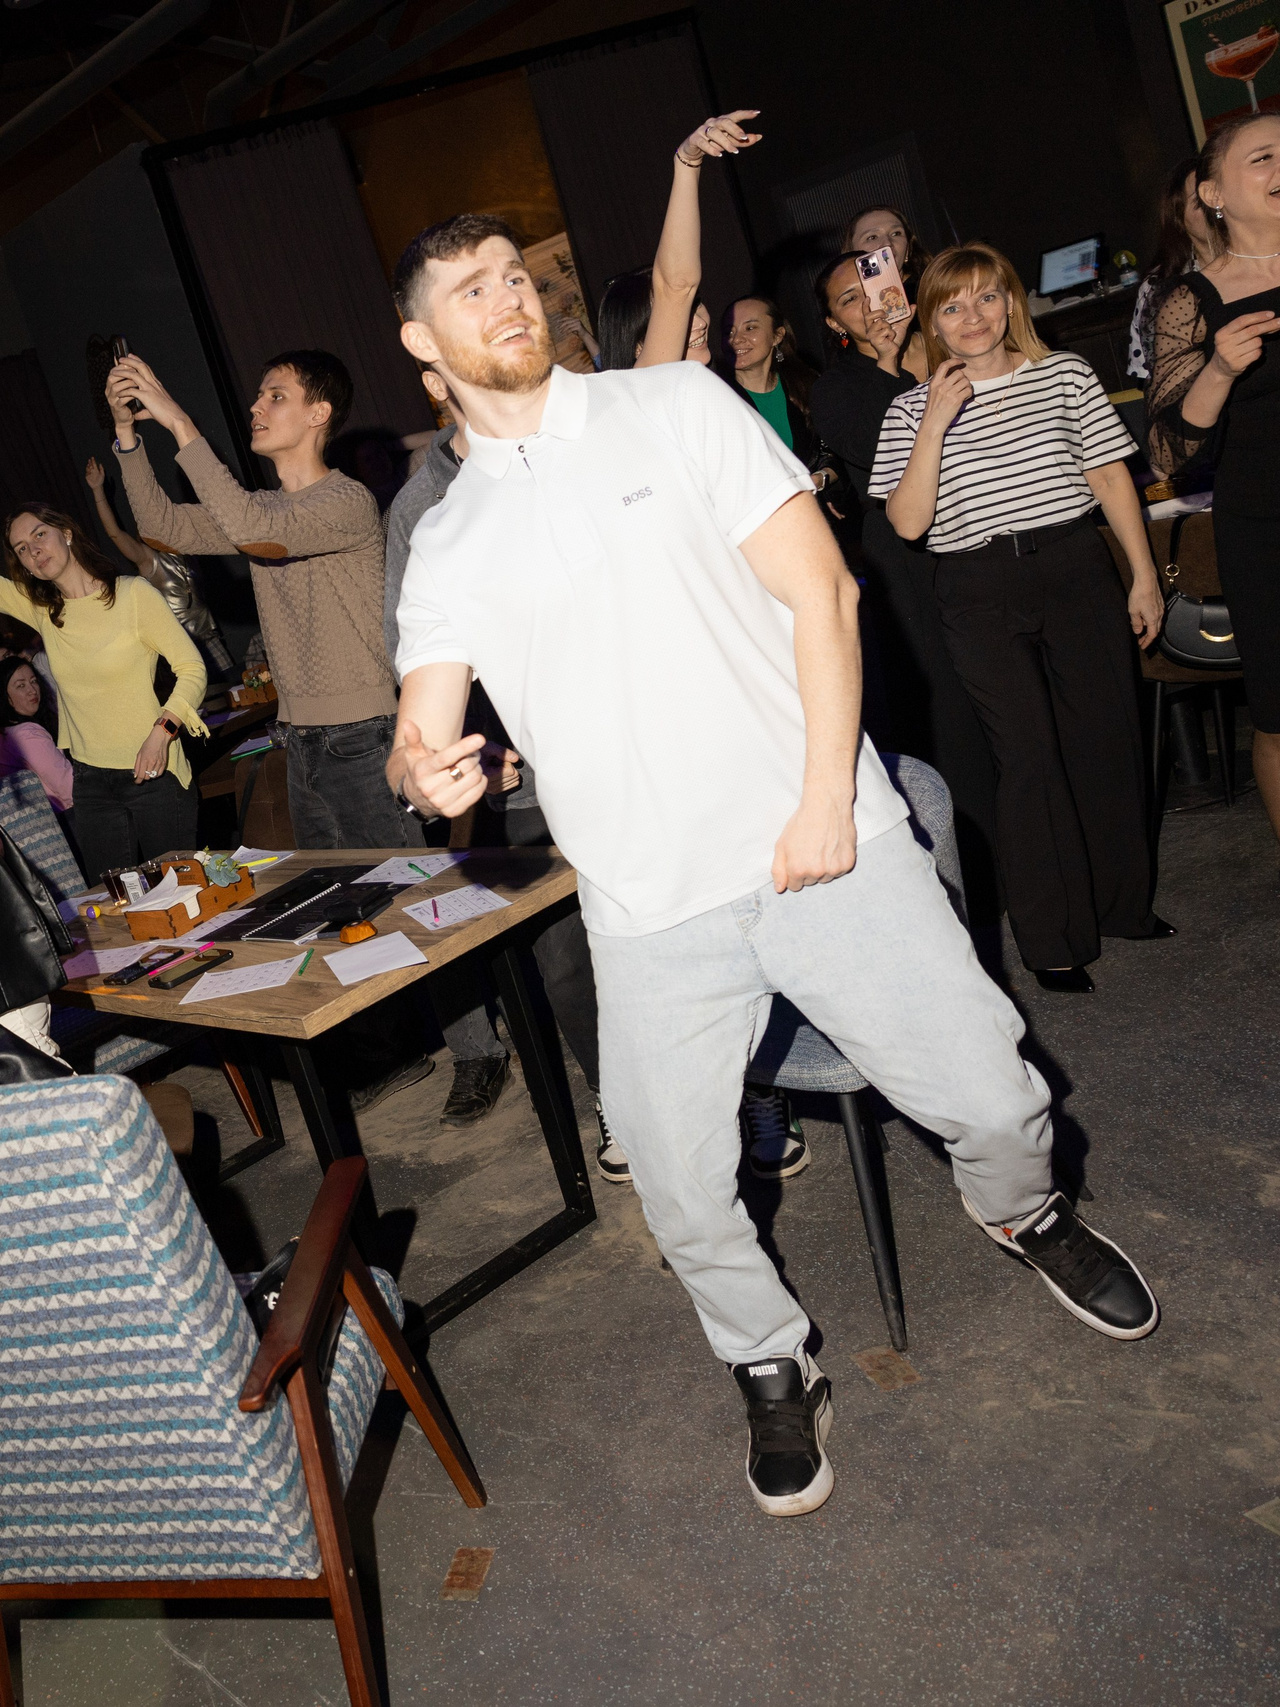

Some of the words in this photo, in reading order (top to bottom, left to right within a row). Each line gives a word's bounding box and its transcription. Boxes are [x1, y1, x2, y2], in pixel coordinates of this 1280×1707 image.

[622, 486, 653, 507] BOSS
[1034, 1210, 1059, 1235] PUMA
[748, 1364, 778, 1377] PUMA
